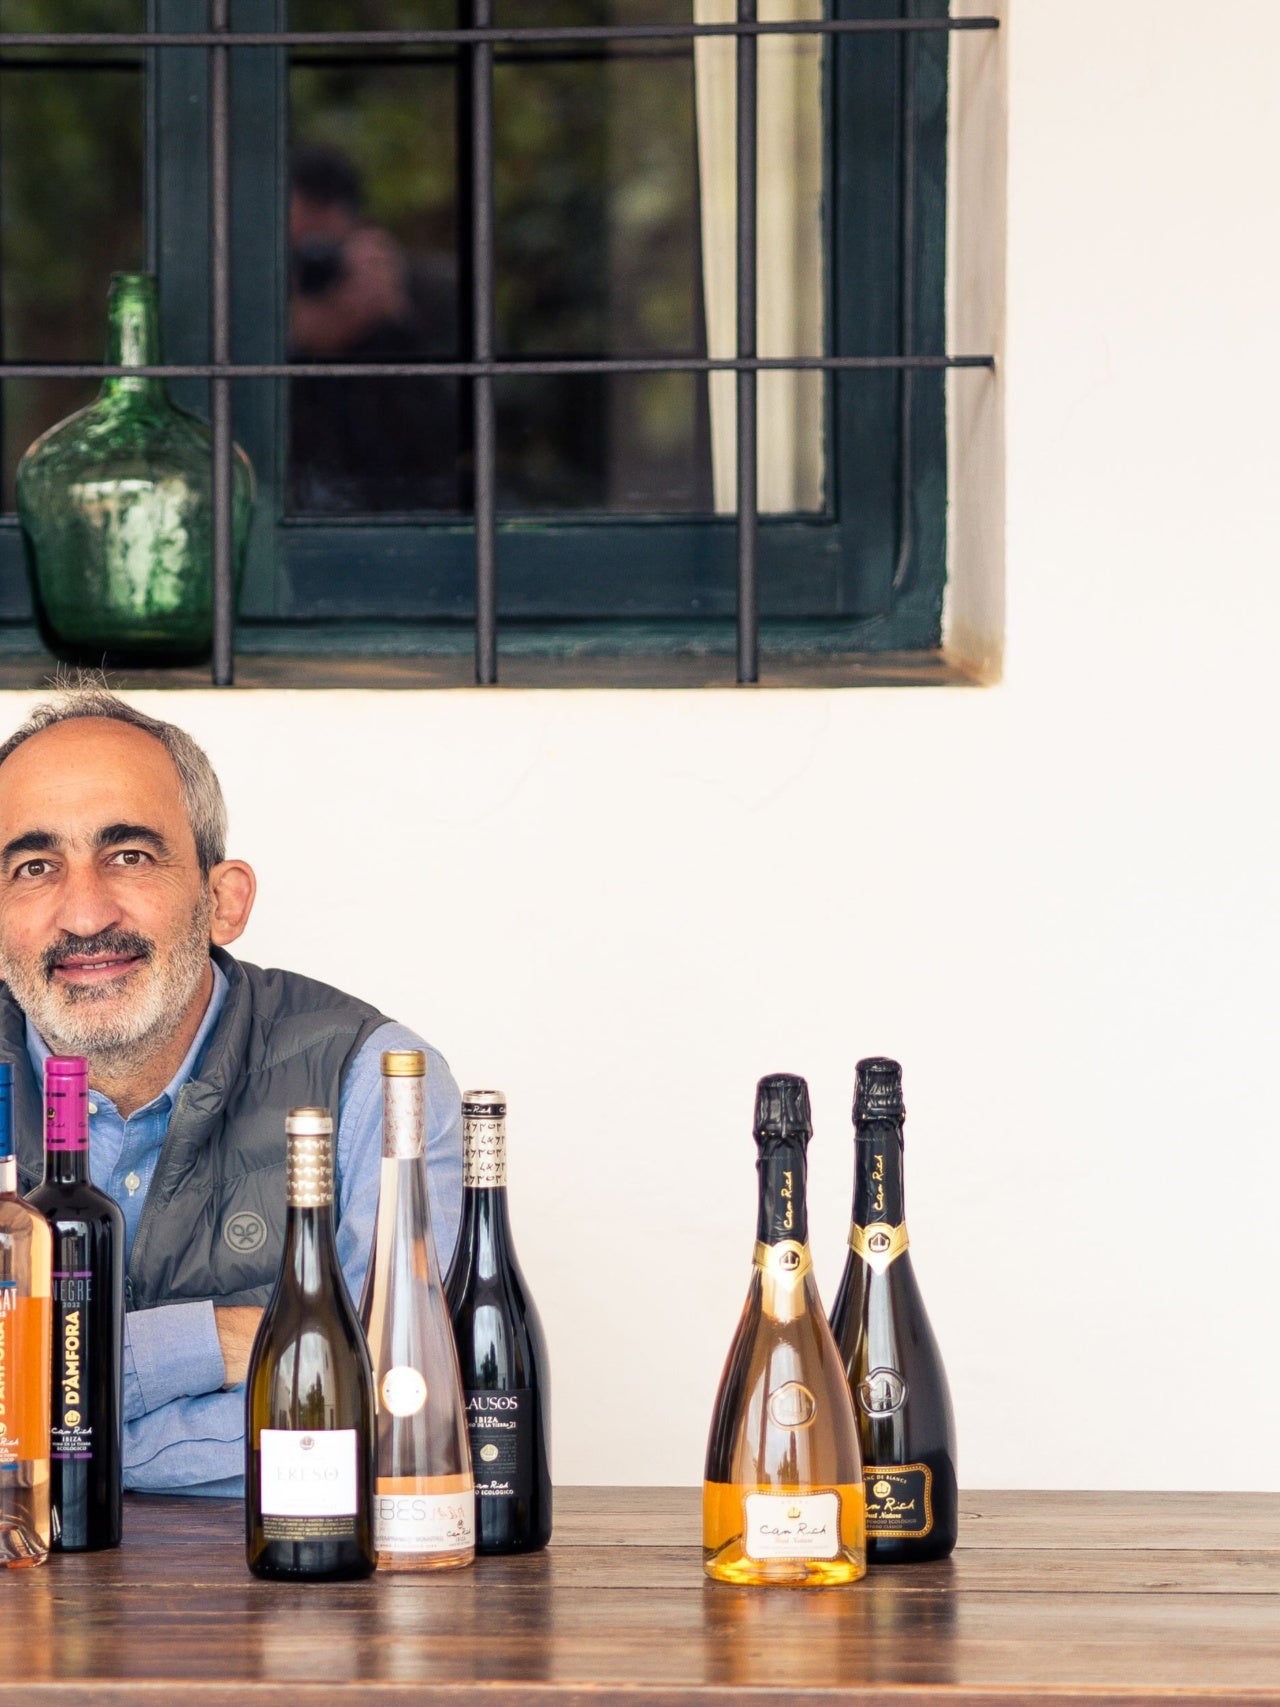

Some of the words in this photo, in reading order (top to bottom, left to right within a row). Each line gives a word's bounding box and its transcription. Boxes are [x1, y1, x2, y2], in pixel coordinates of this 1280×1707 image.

[872, 1154, 884, 1181] Rich
[781, 1171, 793, 1198] Rich
[873, 1183, 884, 1211] Can
[783, 1200, 793, 1229] Can
[465, 1396, 518, 1411] AUSOS
[51, 1427, 71, 1435] Can
[73, 1426, 92, 1435] Rich
[0, 1437, 19, 1446] Rich
[490, 1480, 509, 1490] Rich
[883, 1497, 915, 1511] Rich
[760, 1524, 792, 1537] Can
[797, 1522, 826, 1536] Rich
